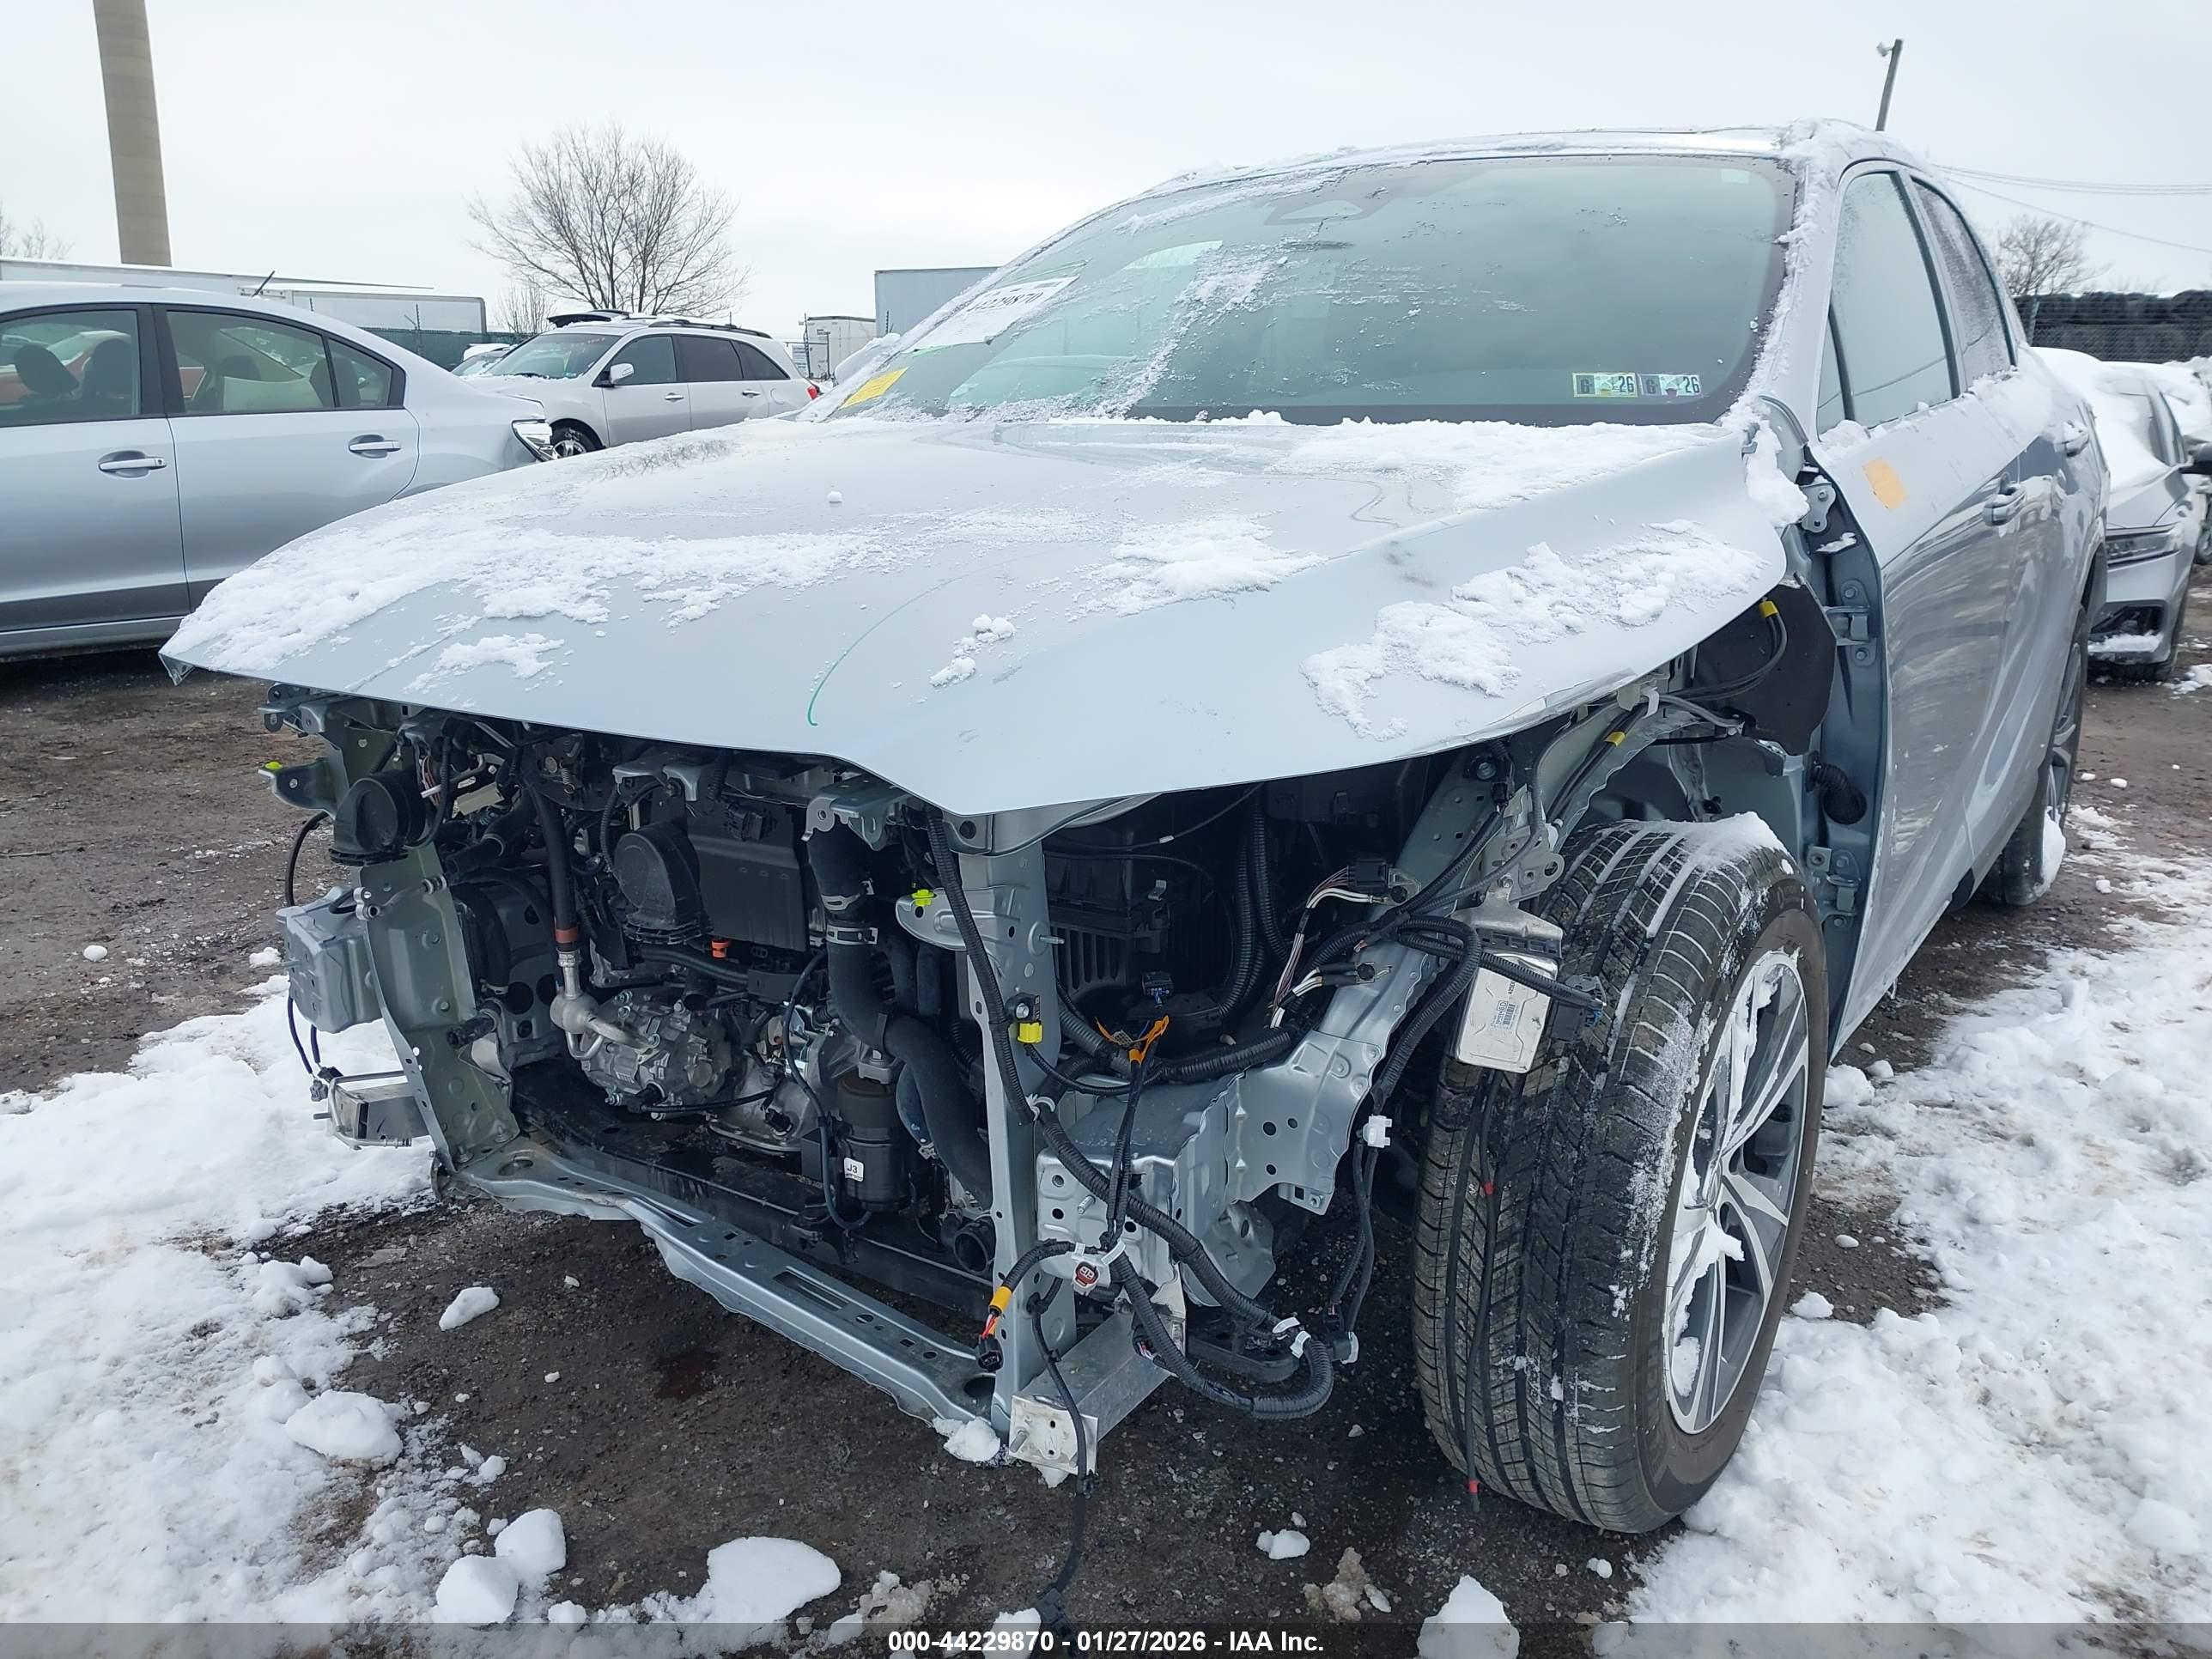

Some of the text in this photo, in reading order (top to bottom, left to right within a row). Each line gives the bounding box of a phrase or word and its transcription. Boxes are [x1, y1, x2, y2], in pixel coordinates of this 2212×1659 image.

[1580, 375, 1635, 394] 6 26
[1646, 376, 1700, 394] 6 26
[847, 1164, 858, 1174] J3
